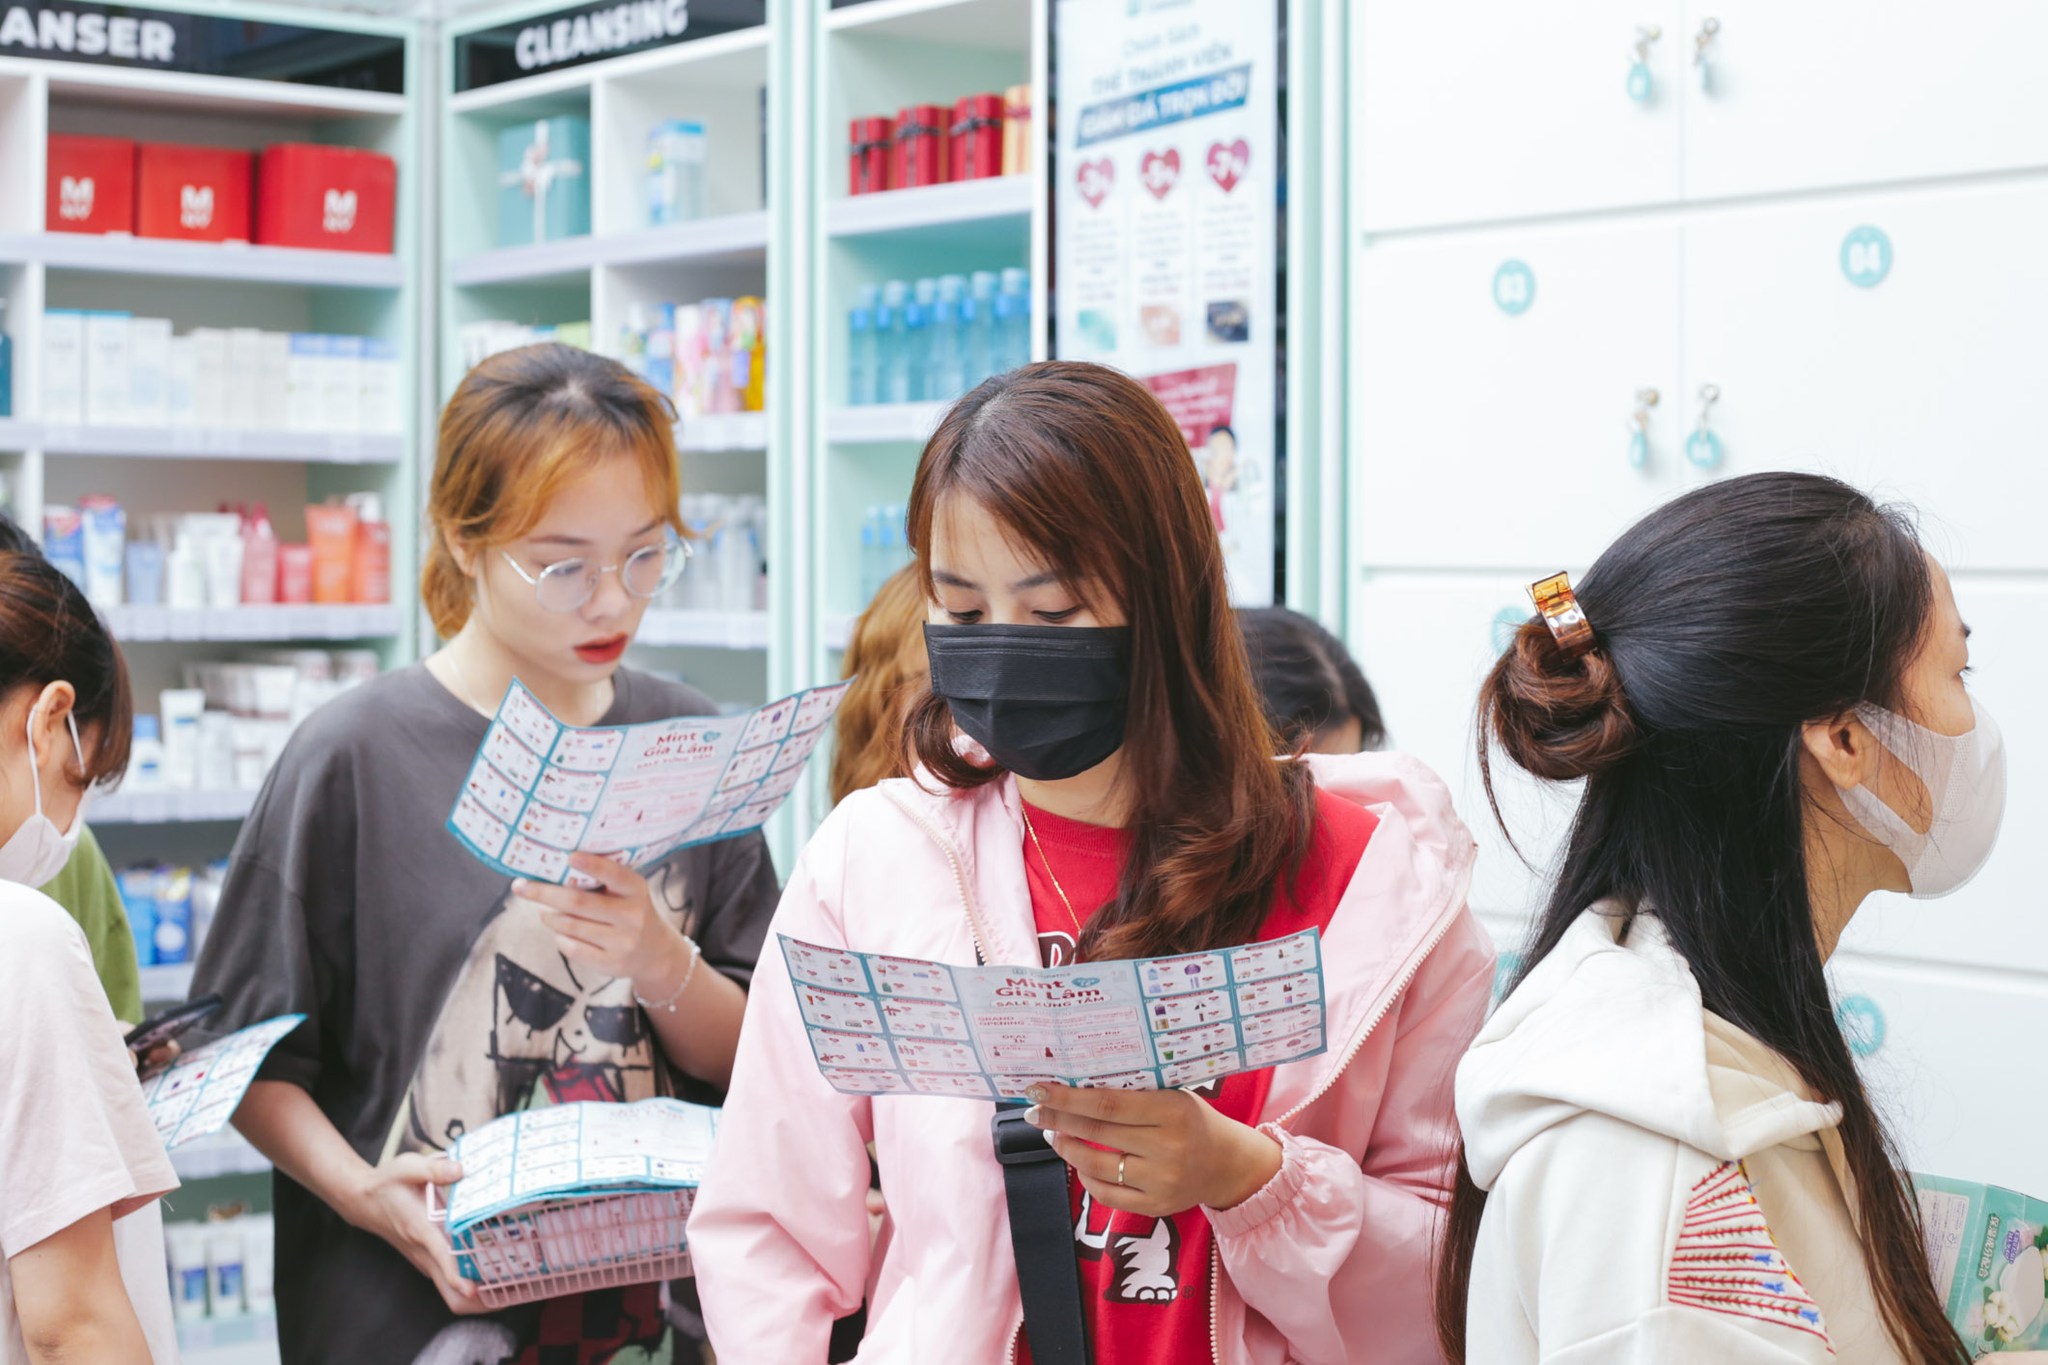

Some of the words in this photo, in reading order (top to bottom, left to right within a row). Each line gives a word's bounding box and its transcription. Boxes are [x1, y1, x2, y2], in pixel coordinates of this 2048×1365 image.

[0, 6, 175, 62] ANSER
[515, 0, 688, 70] CLEANSING
[656, 732, 697, 745] Mint
[1005, 978, 1066, 989] Mint
[995, 987, 1037, 998] Gia
[1046, 988, 1100, 1000] Lâm
[995, 1000, 1029, 1008] SALE
